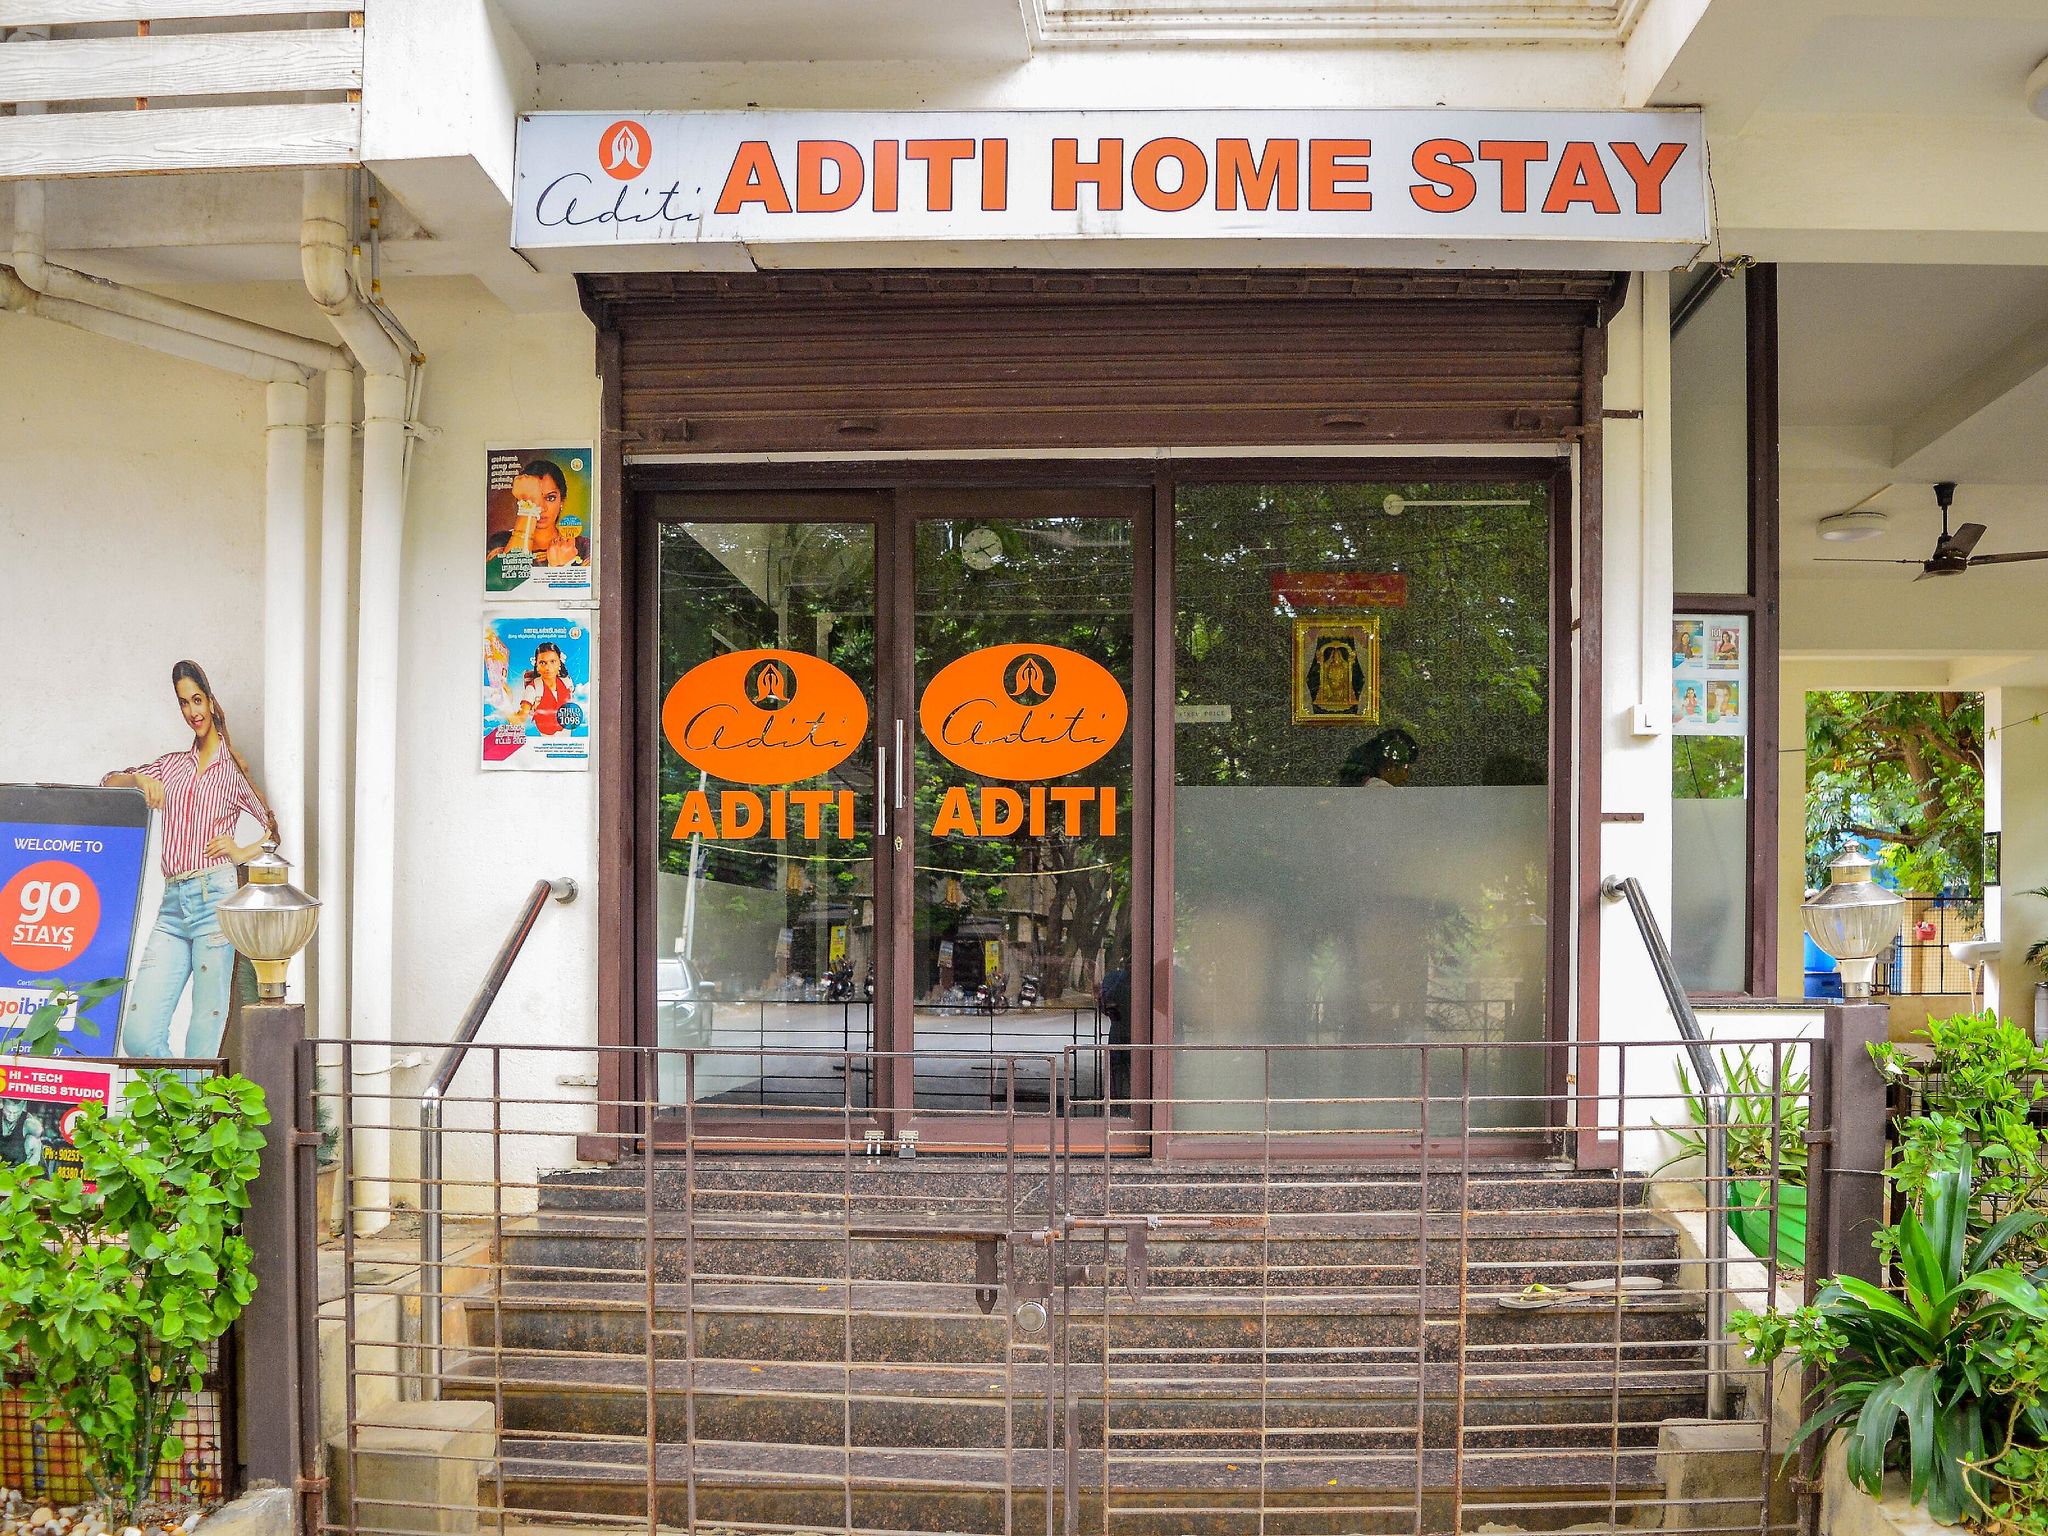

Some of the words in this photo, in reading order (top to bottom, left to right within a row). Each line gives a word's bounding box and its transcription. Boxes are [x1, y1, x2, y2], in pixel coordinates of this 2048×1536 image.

[714, 139, 1009, 214] ADITI
[1050, 136, 1373, 213] HOME
[1408, 138, 1688, 214] STAY
[559, 716, 580, 725] 1098
[671, 790, 855, 840] ADITI
[931, 786, 1117, 837] ADITI
[14, 838, 83, 852] WELCOME
[84, 840, 103, 853] TO
[18, 880, 81, 923] go
[12, 924, 75, 944] STAYS
[9, 1070, 21, 1080] HI
[31, 1072, 63, 1083] TECH
[8, 1082, 57, 1095] FITNESS
[59, 1087, 105, 1099] STUDIO
